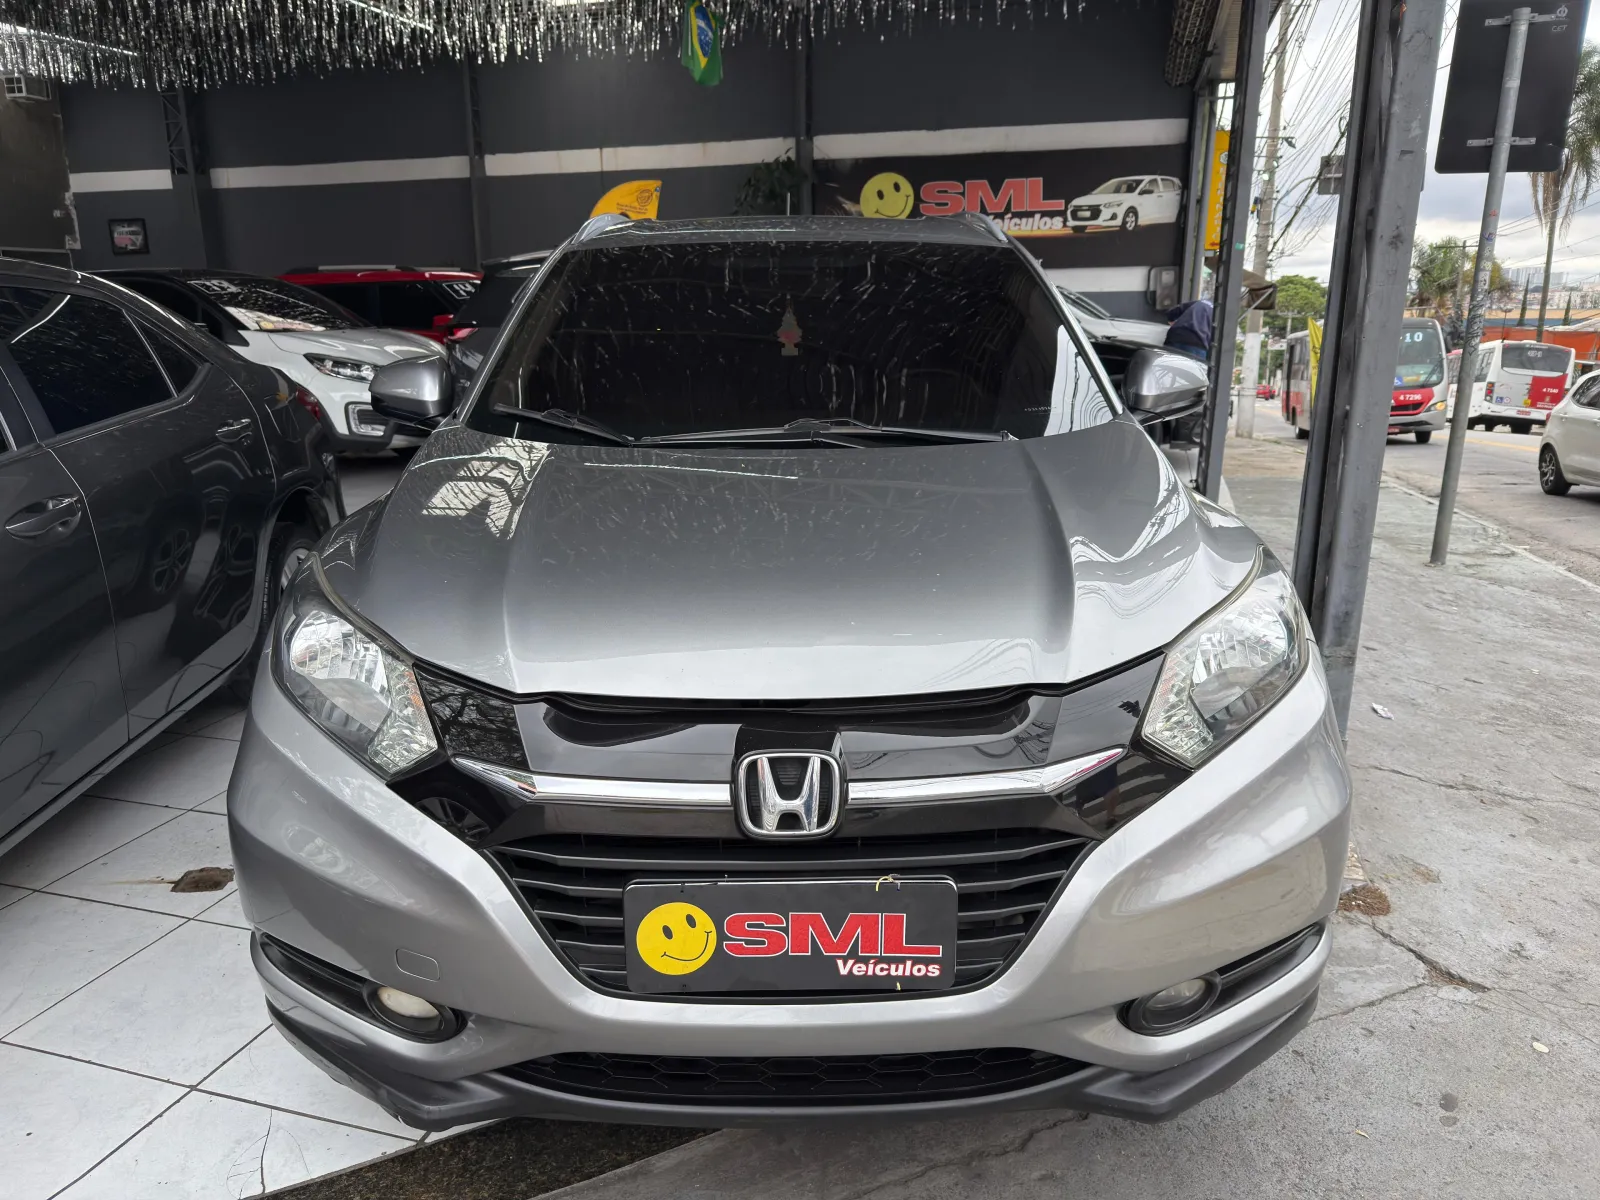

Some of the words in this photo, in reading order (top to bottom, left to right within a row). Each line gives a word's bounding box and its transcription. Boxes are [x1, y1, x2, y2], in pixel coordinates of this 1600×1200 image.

[920, 177, 1065, 217] SML
[988, 213, 1064, 231] eículos
[723, 912, 943, 957] SML
[836, 958, 941, 977] Veículos
